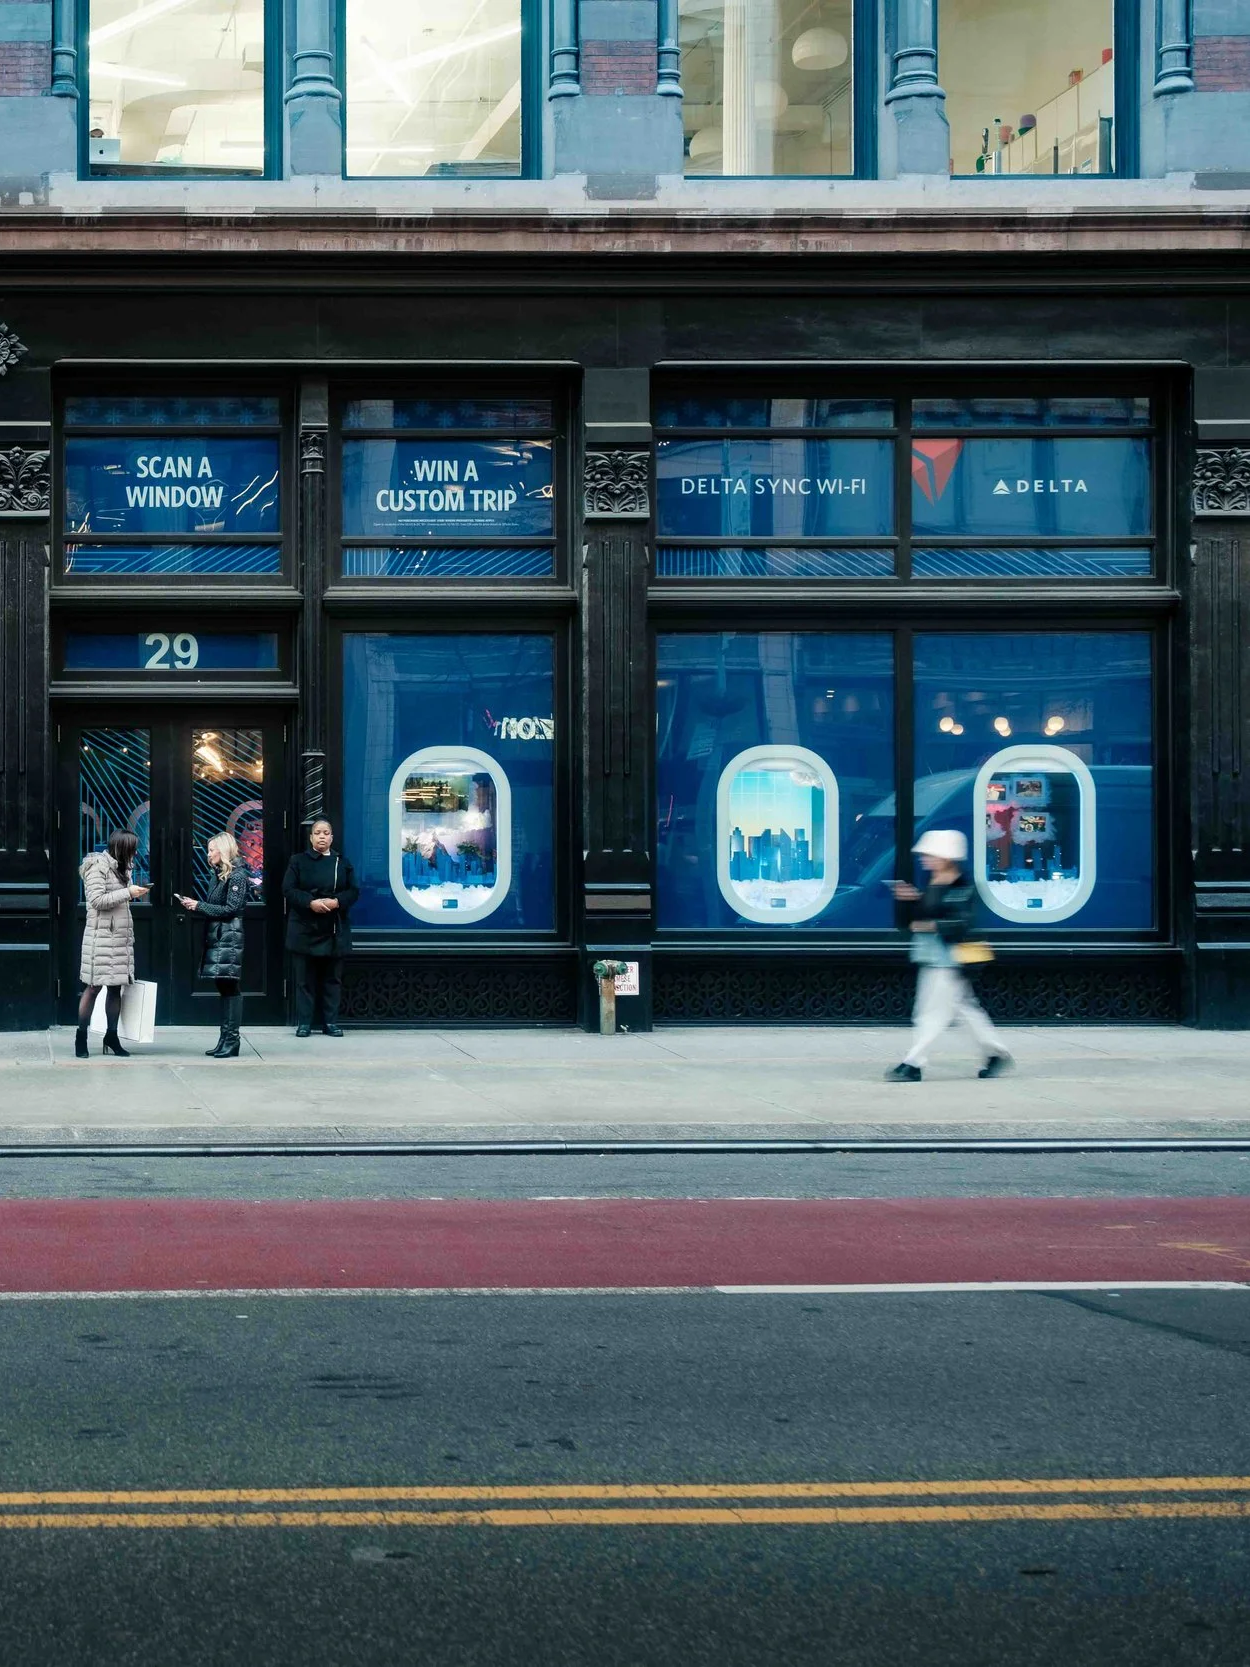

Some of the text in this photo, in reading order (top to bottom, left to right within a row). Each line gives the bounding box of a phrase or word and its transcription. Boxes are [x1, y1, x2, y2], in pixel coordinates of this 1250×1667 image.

[136, 456, 213, 478] SCAN A
[414, 460, 479, 482] WIN A
[125, 486, 224, 508] WINDOW
[681, 478, 866, 495] DELTA SYNC WI-FI
[1016, 479, 1088, 493] DELTA
[376, 489, 517, 512] CUSTOM TRIP
[144, 633, 199, 669] 29
